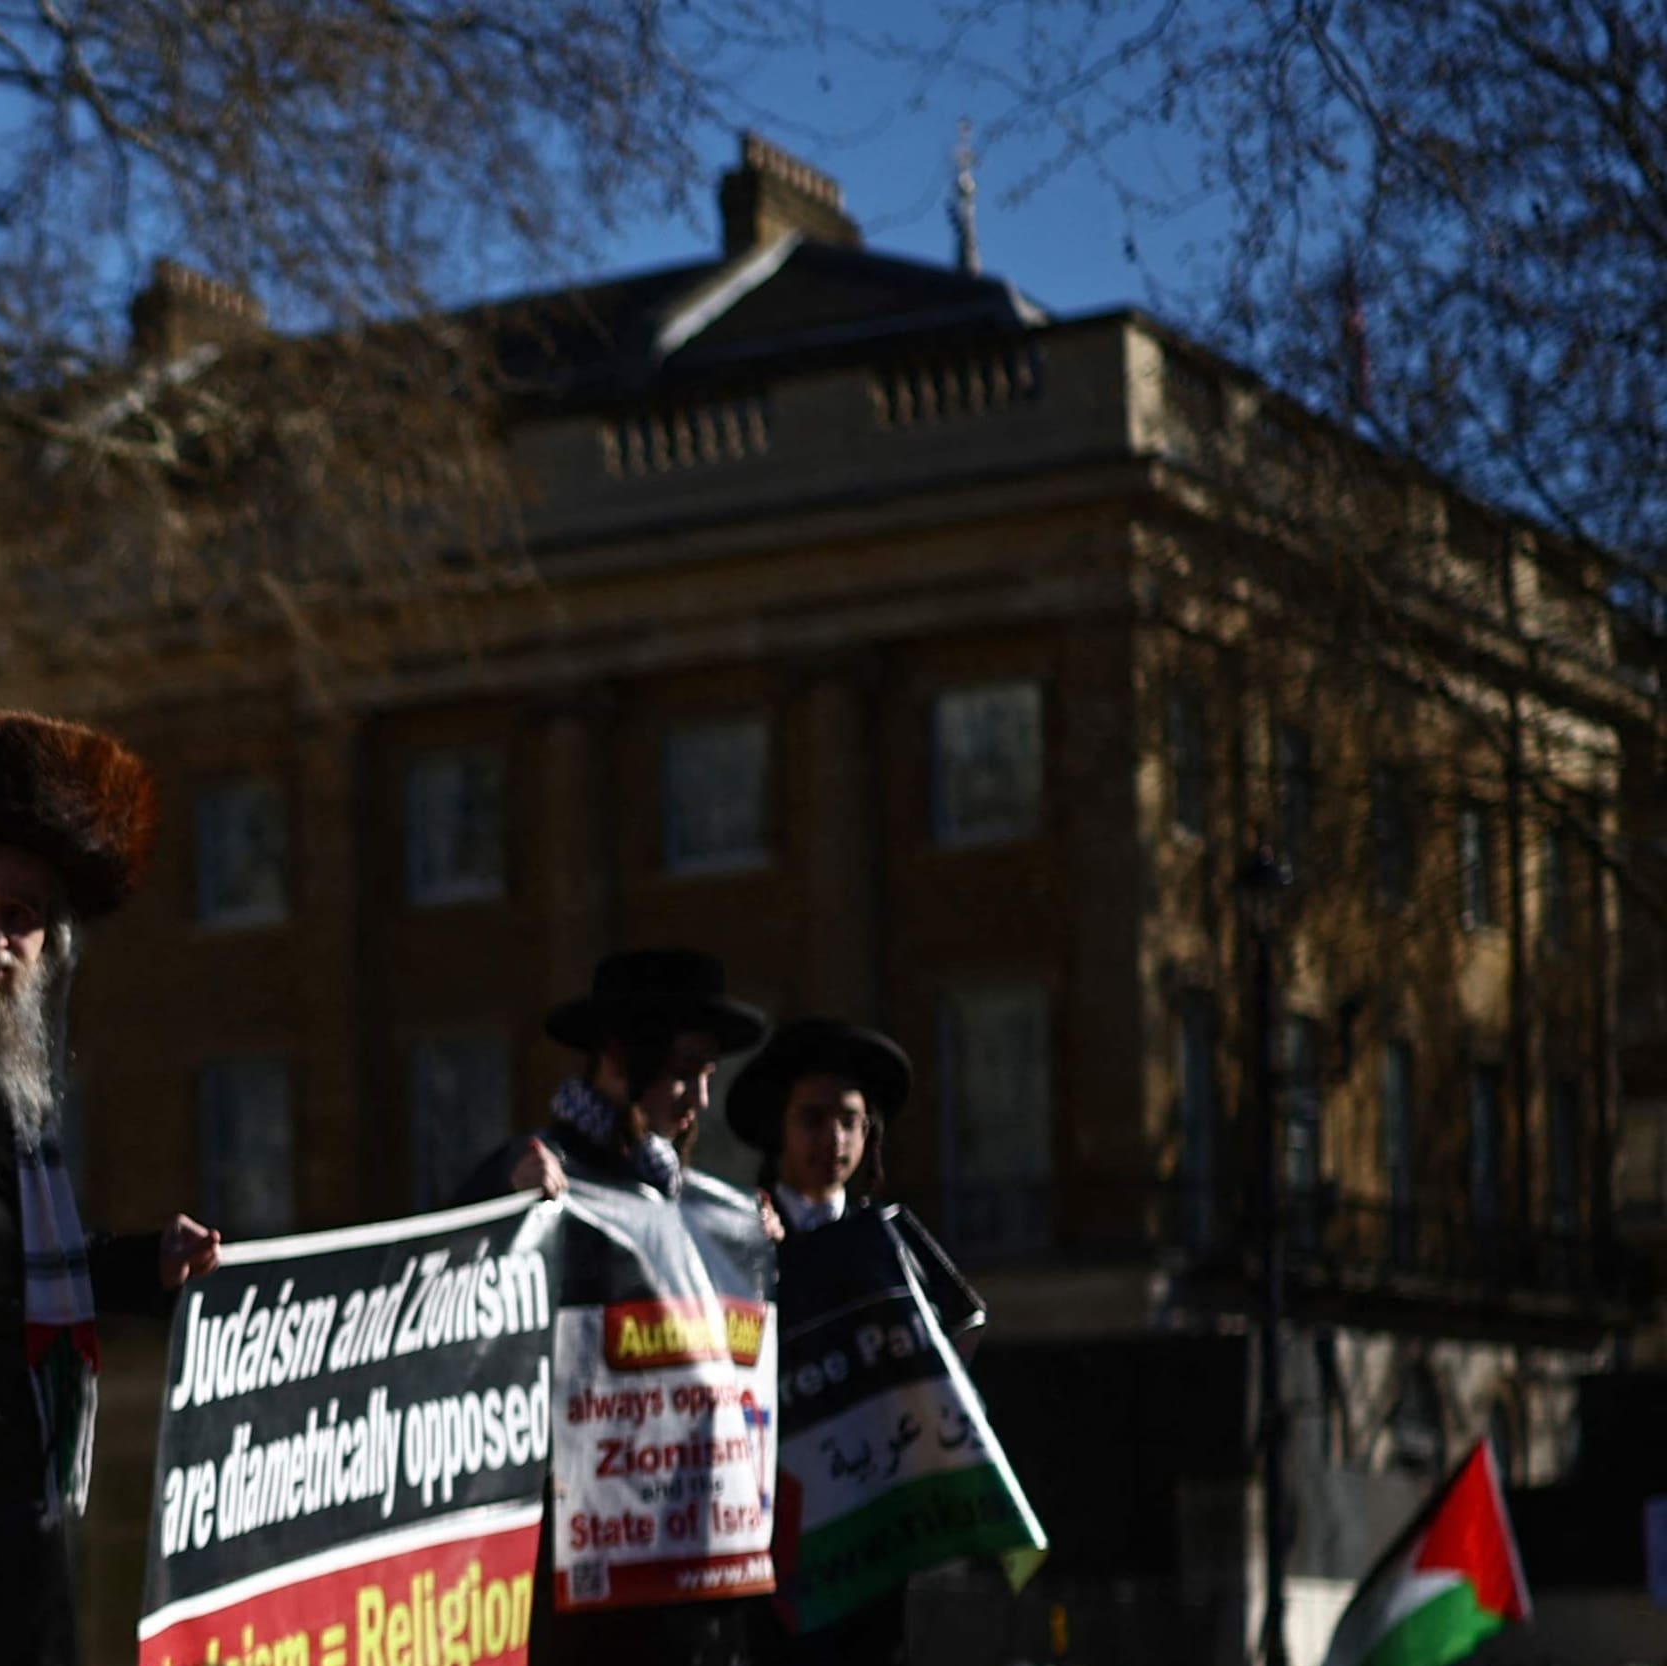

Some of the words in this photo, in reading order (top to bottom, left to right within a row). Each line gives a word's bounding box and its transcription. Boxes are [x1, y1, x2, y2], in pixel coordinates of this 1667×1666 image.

[171, 1277, 338, 1411] Judaism
[327, 1255, 419, 1374] and
[393, 1237, 551, 1357] Zionism
[567, 1384, 665, 1429] always
[161, 1458, 217, 1559] are
[216, 1384, 403, 1542] diametrically
[404, 1355, 551, 1507] opposed
[595, 1430, 751, 1480] Zionism
[569, 1507, 658, 1550] State
[666, 1501, 700, 1540] of
